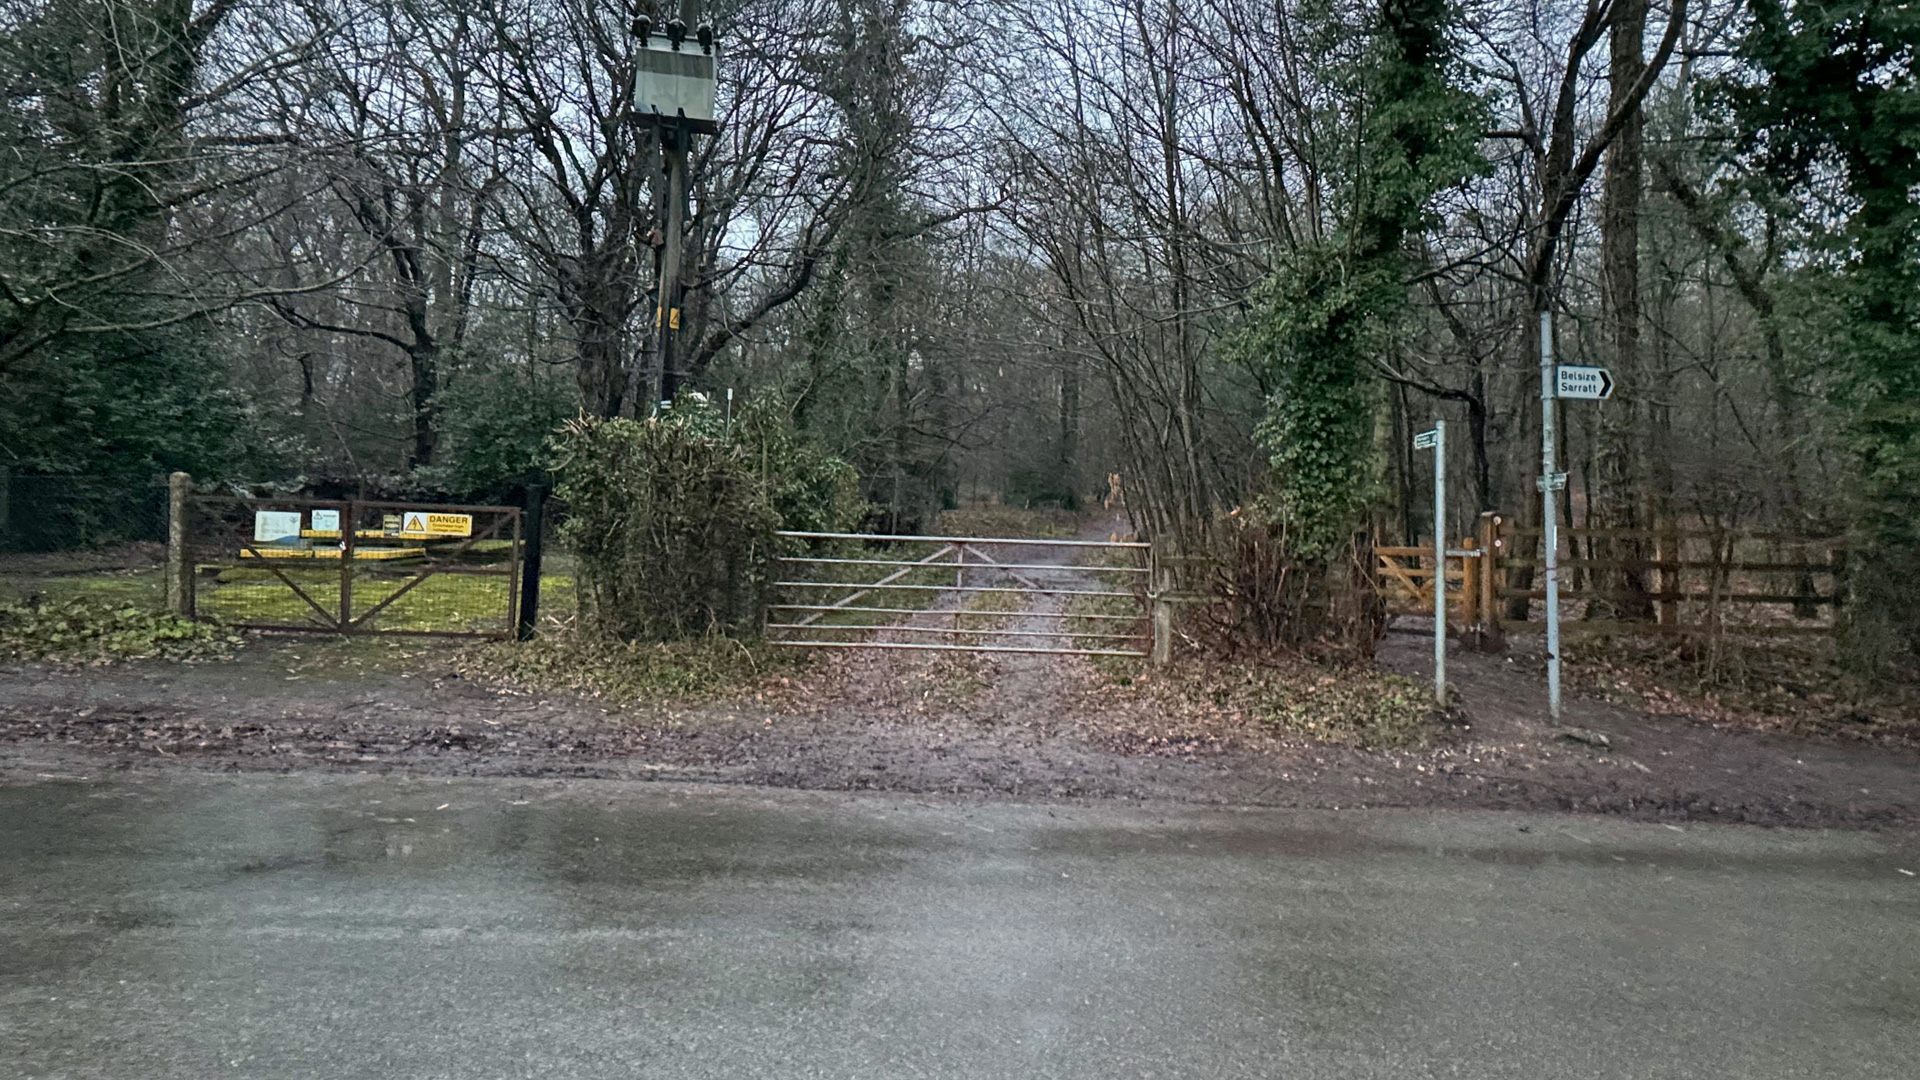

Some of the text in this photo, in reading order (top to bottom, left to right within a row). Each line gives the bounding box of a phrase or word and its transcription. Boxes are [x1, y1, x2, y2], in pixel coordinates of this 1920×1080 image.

[1561, 370, 1597, 381] Belsize
[1561, 382, 1597, 393] Sarratt
[429, 515, 468, 524] DANGER
